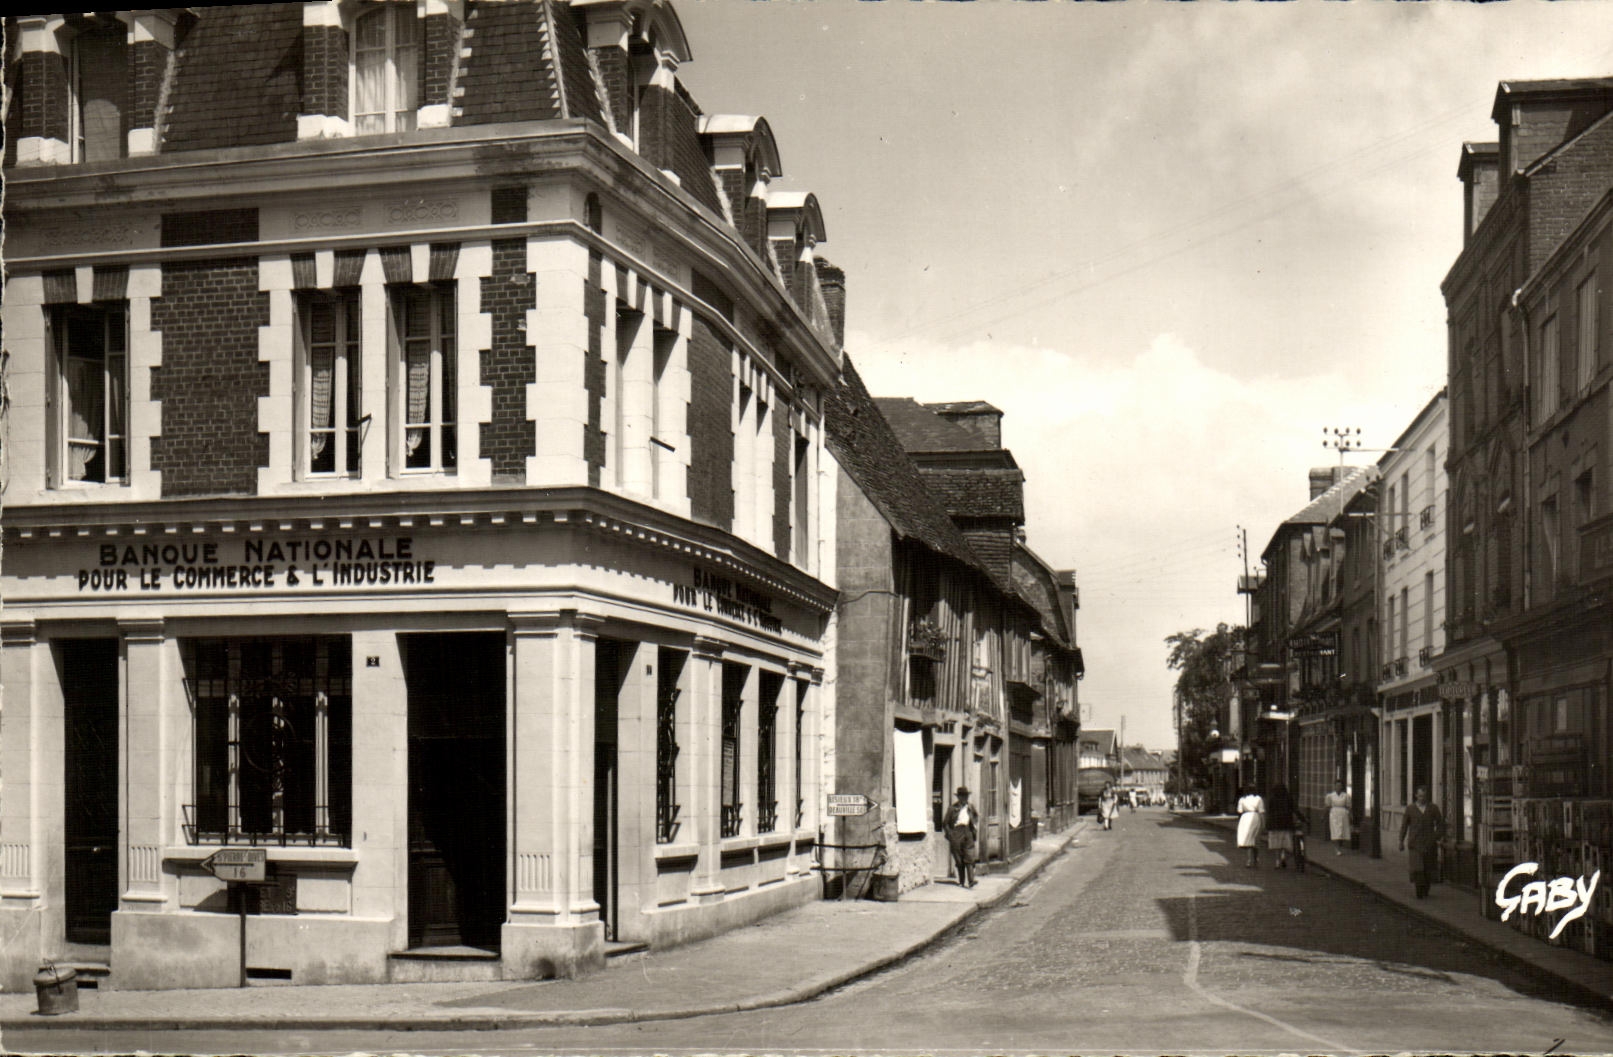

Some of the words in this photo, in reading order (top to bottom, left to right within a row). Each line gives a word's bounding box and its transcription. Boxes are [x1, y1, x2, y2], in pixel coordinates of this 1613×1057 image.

[100, 543, 219, 567] BANQUE
[244, 537, 414, 562] NATIONALE
[78, 569, 128, 591] POUR
[140, 567, 161, 590] LE
[173, 564, 275, 590] COMMERCE
[286, 564, 300, 587] &
[233, 867, 247, 878] 16
